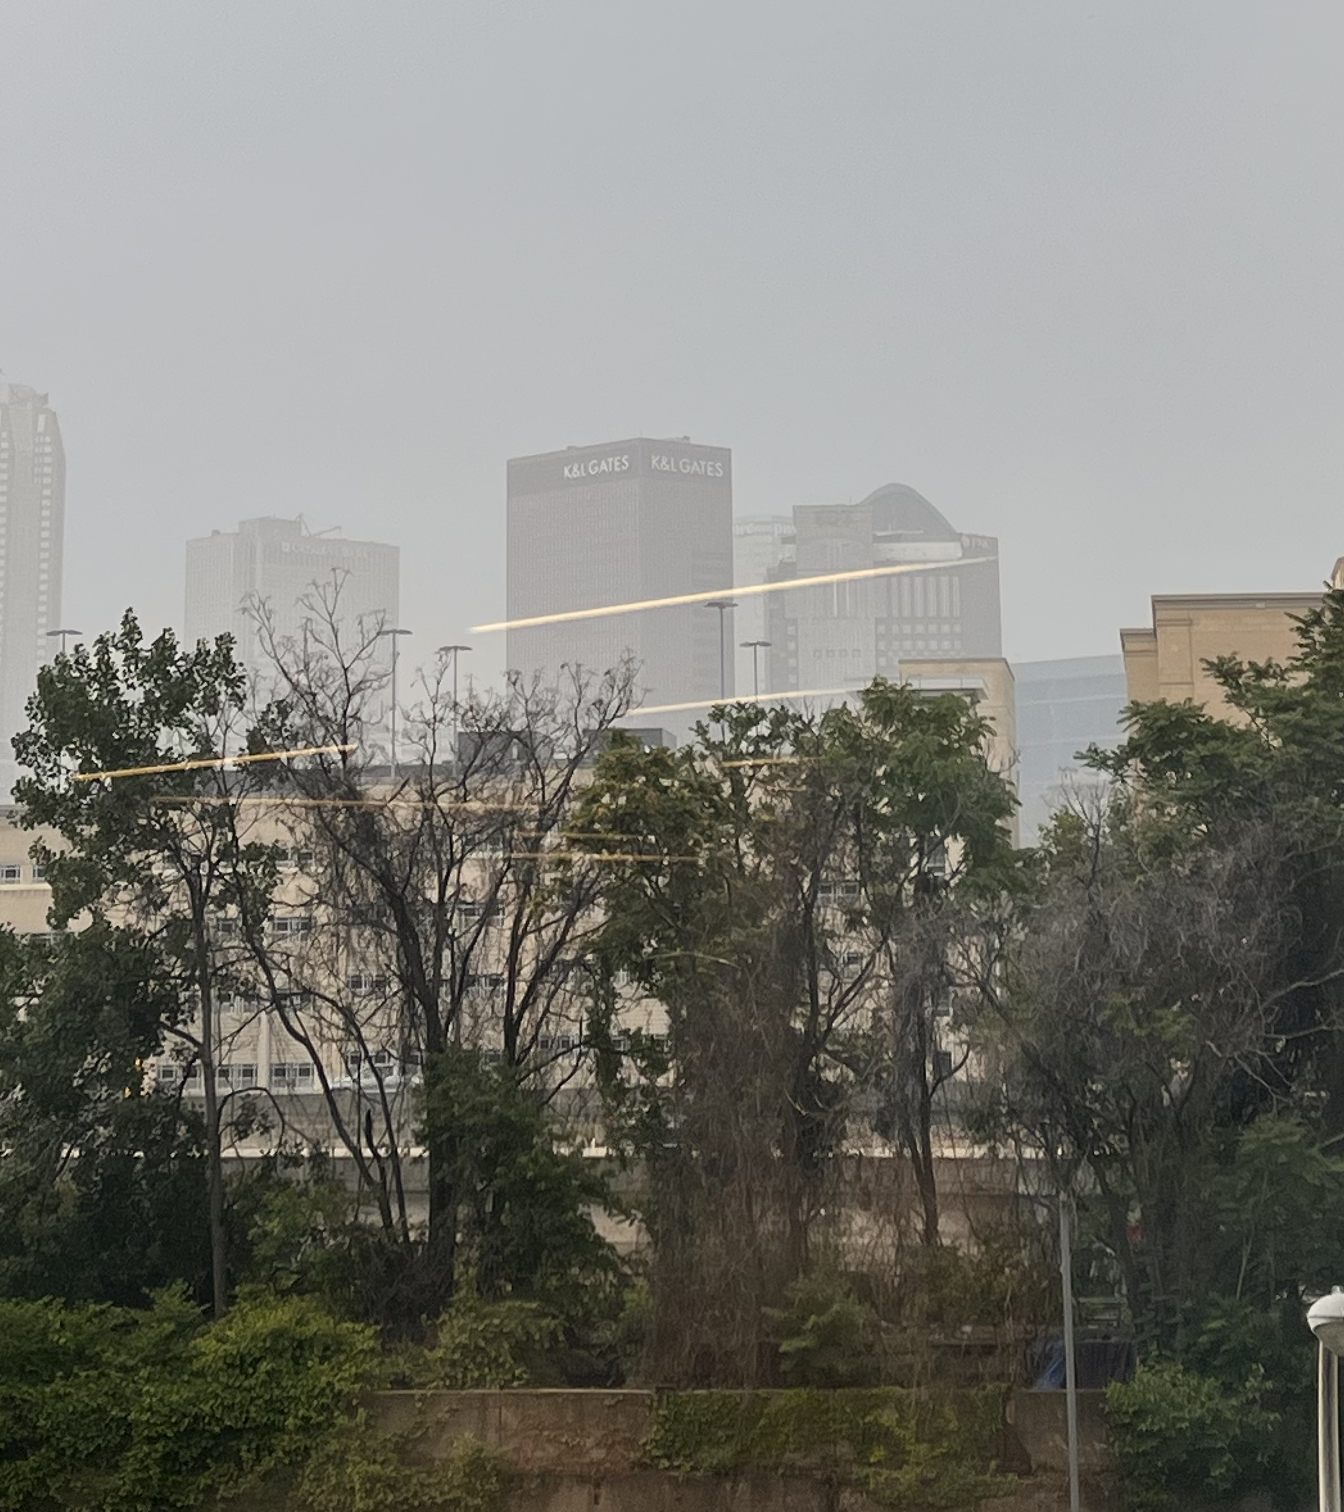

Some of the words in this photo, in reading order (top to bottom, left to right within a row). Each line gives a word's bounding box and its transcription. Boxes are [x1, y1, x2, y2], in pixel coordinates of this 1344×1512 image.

[563, 464, 586, 479] K&L
[588, 455, 629, 476] GATES
[651, 455, 677, 472] K&L
[679, 458, 724, 478] GATES
